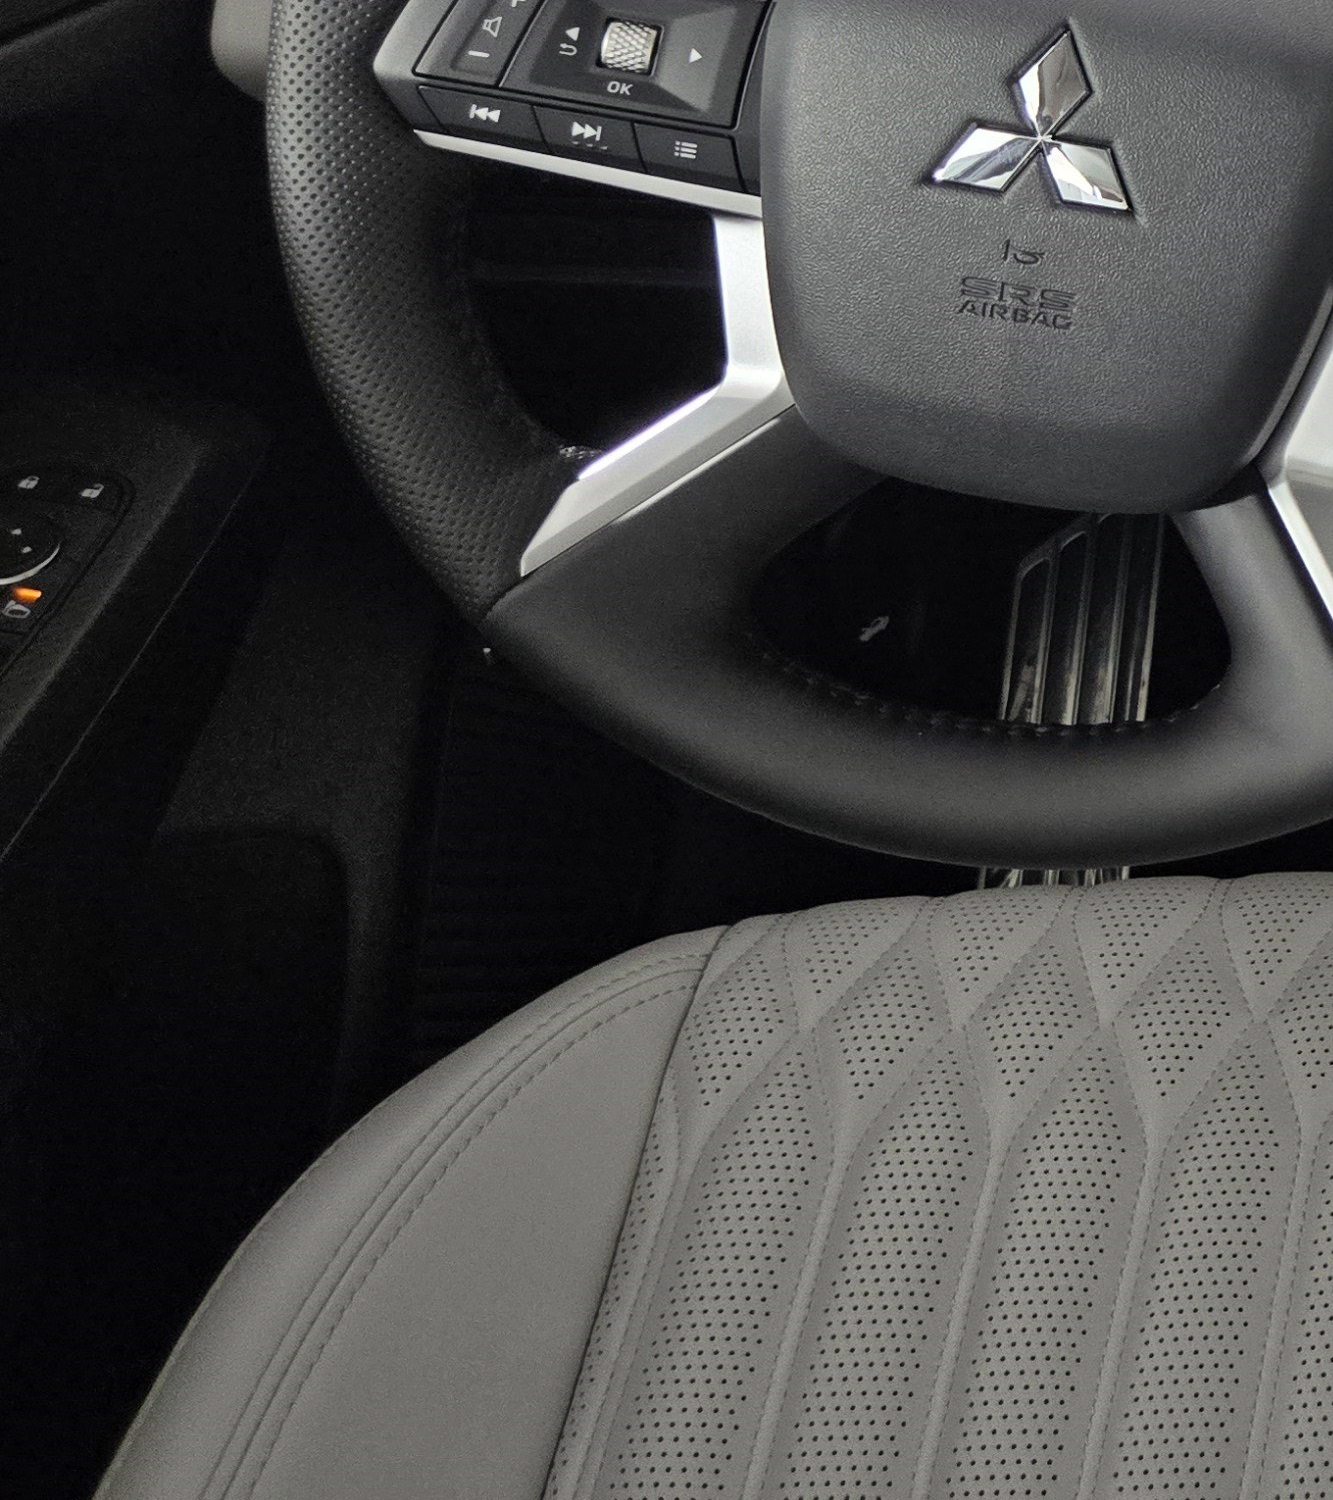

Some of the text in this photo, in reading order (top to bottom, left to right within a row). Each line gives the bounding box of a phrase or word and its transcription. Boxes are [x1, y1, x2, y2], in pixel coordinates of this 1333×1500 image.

[606, 80, 633, 96] OK
[960, 276, 1077, 312] SRS
[957, 299, 1073, 330] AIRBAG
